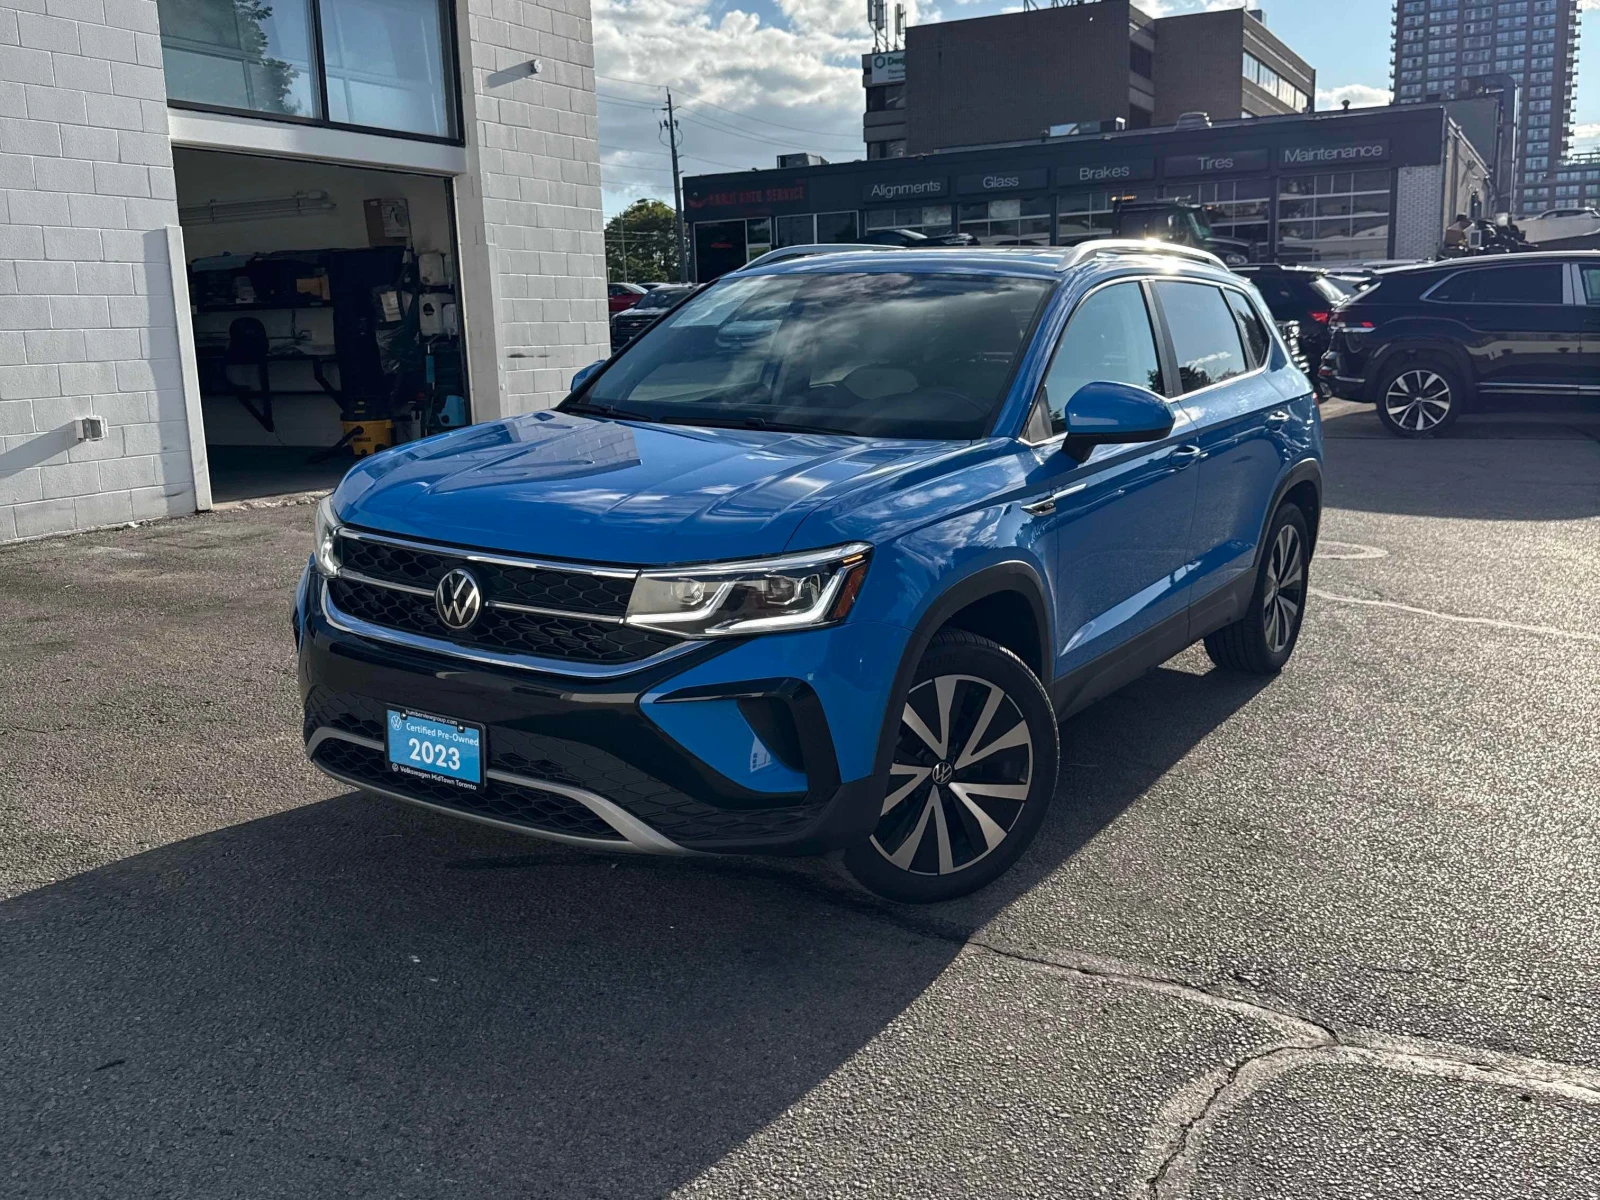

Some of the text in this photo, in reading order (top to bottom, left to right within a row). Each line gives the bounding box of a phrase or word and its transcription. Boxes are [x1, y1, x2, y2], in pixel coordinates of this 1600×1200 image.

[1284, 143, 1383, 163] Maintenance
[1198, 156, 1234, 171] Tires
[1079, 165, 1129, 181] Brakes
[871, 181, 941, 199] Alignments
[983, 176, 1019, 189] Glass
[405, 709, 458, 726] humberviewgroup.com
[406, 722, 479, 747] Certified Pre-Owned
[408, 738, 461, 771] 2023
[400, 765, 477, 791] Volkswagen MidTown Toronto
